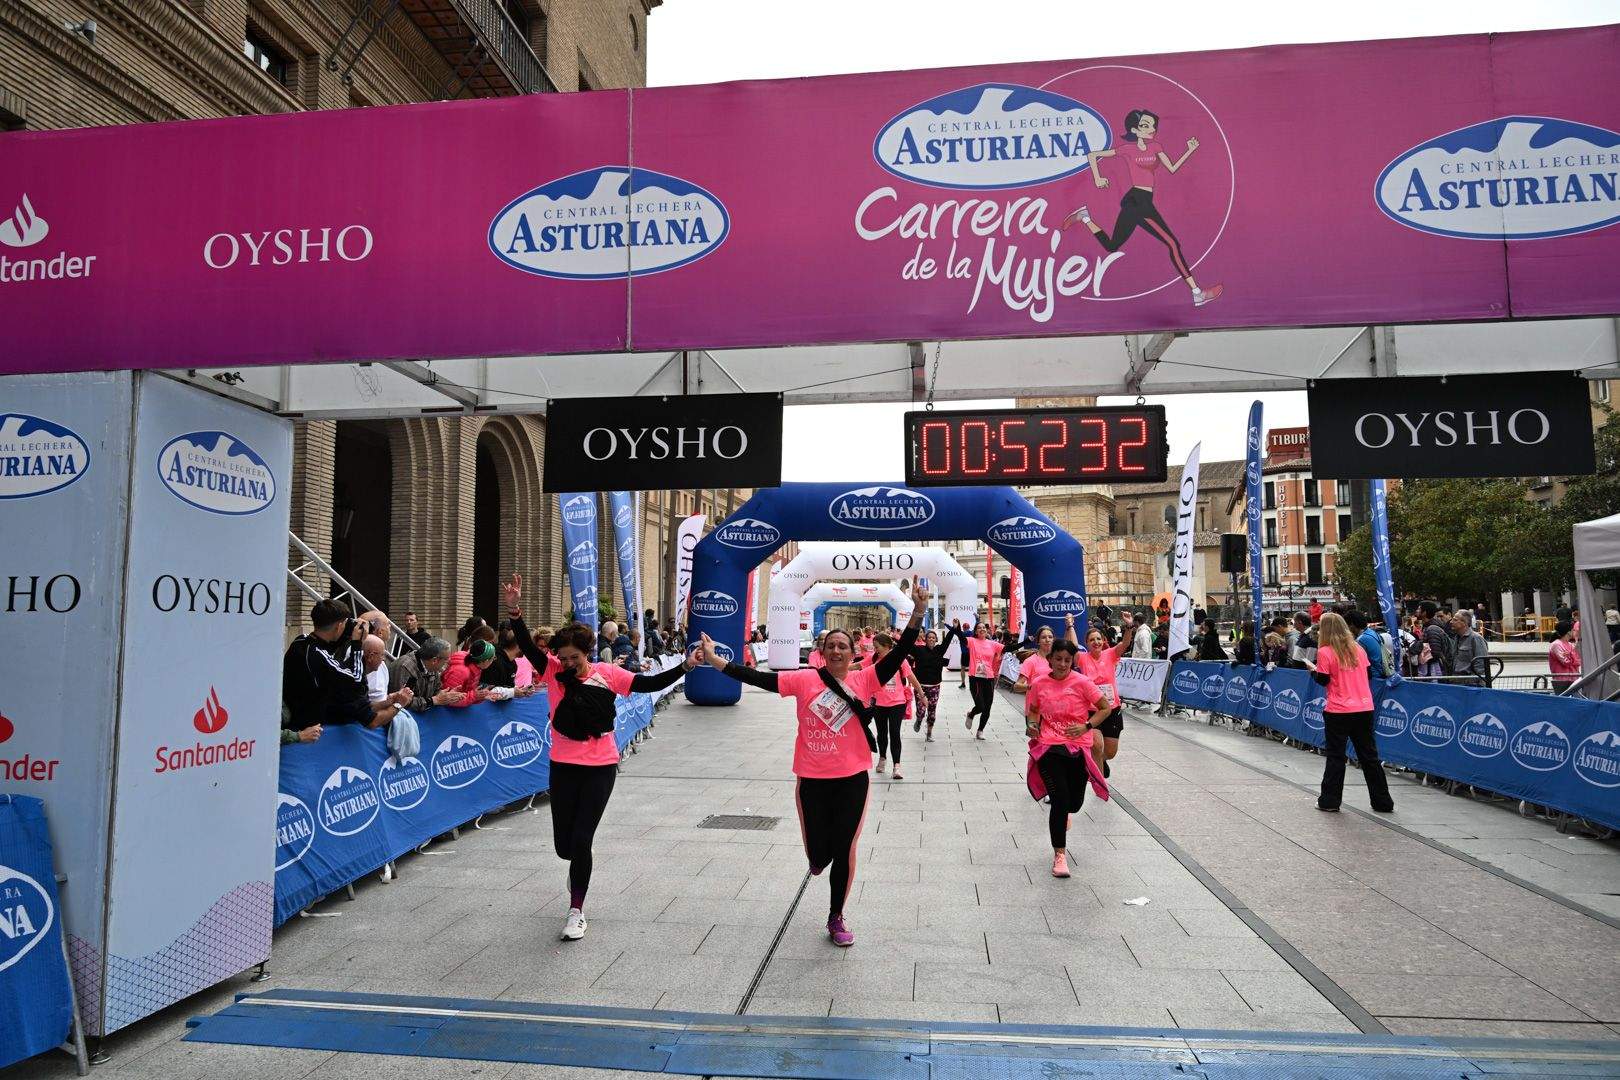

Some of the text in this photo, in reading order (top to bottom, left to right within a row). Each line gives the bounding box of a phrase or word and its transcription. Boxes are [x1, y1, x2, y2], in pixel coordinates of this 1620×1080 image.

[928, 116, 1085, 134] CENTRAL LECHERA
[892, 126, 1093, 166] ASTURIANA
[1440, 158, 1530, 175] CENTRAL
[1398, 167, 1620, 213] ASTURIAN
[543, 200, 704, 220] CENTRAL LECHERA
[854, 186, 1049, 242] Carrera
[508, 211, 711, 255] ASTURIANA
[203, 224, 374, 270] OYSHO
[0, 251, 97, 283] tander
[901, 228, 1126, 323] de la Mujer
[1271, 433, 1306, 446] TIBUR
[1354, 407, 1550, 449] OYSHO
[21, 441, 74, 451] LECHERA
[582, 425, 749, 461] OYSHO
[0, 454, 77, 477] RIANA
[166, 450, 269, 503] ASTURIANA
[187, 451, 267, 479] CENTRAL LECHERA
[836, 499, 928, 520] ASTURIANA
[719, 528, 775, 542] ASTURIANA
[992, 528, 1052, 541] ASTURIANA
[832, 553, 914, 571] OYSHO
[783, 572, 809, 580] OYSHO
[936, 570, 962, 578] OYSHO
[6, 574, 81, 613] HO
[152, 573, 271, 616] OYSHO
[692, 599, 735, 612] ASTURIANA
[1036, 600, 1084, 613] ASTURIANA
[806, 717, 816, 727] TU
[1413, 717, 1452, 740] ASTURIANA
[807, 728, 848, 740] DORSAL
[1460, 726, 1504, 750] ASTURIANA
[154, 737, 256, 774] Santander
[497, 738, 541, 761] ASTURIANA
[807, 742, 839, 753] SUMA
[1513, 735, 1565, 763] ASTURIANA
[435, 754, 486, 782] ASTURIANA
[383, 773, 428, 801] ASTURIANA
[325, 789, 378, 827] ASTURIANA
